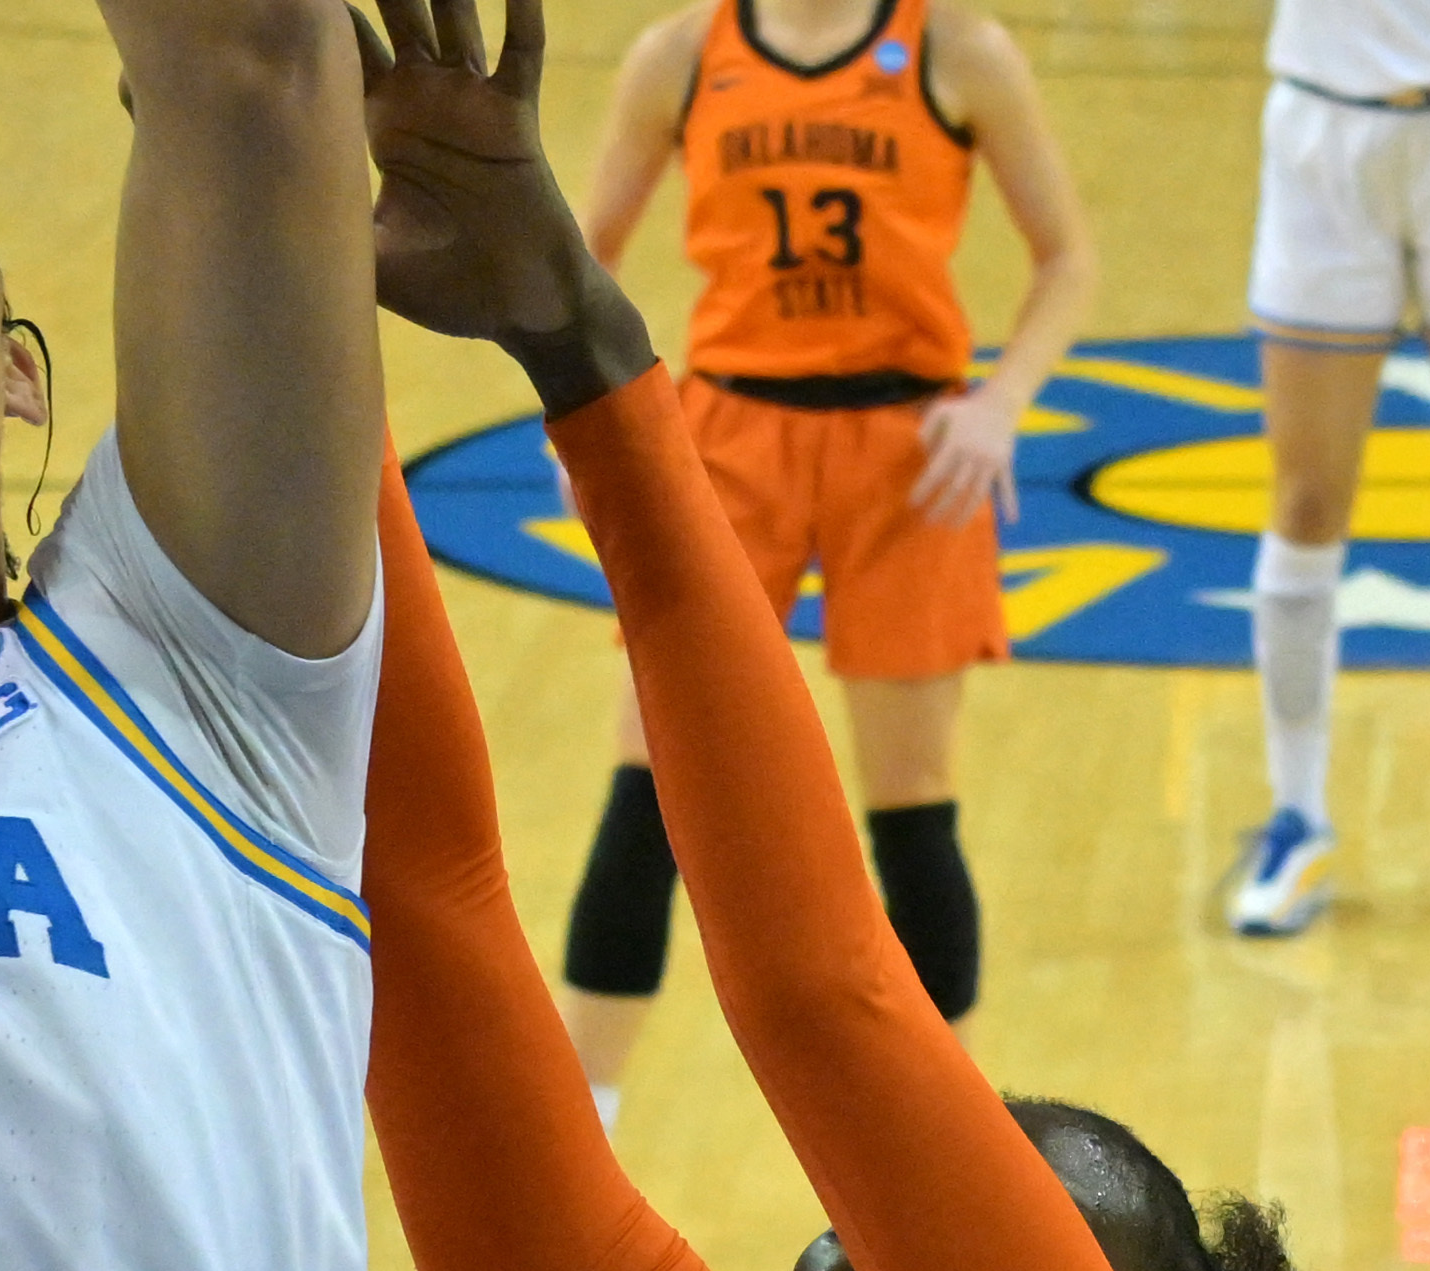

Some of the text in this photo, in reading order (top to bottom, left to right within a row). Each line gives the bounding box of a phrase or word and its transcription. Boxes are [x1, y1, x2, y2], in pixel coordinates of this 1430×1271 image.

[717, 118, 901, 176] OKLAHOMA
[762, 187, 863, 269] 13
[771, 269, 866, 319] STATE
